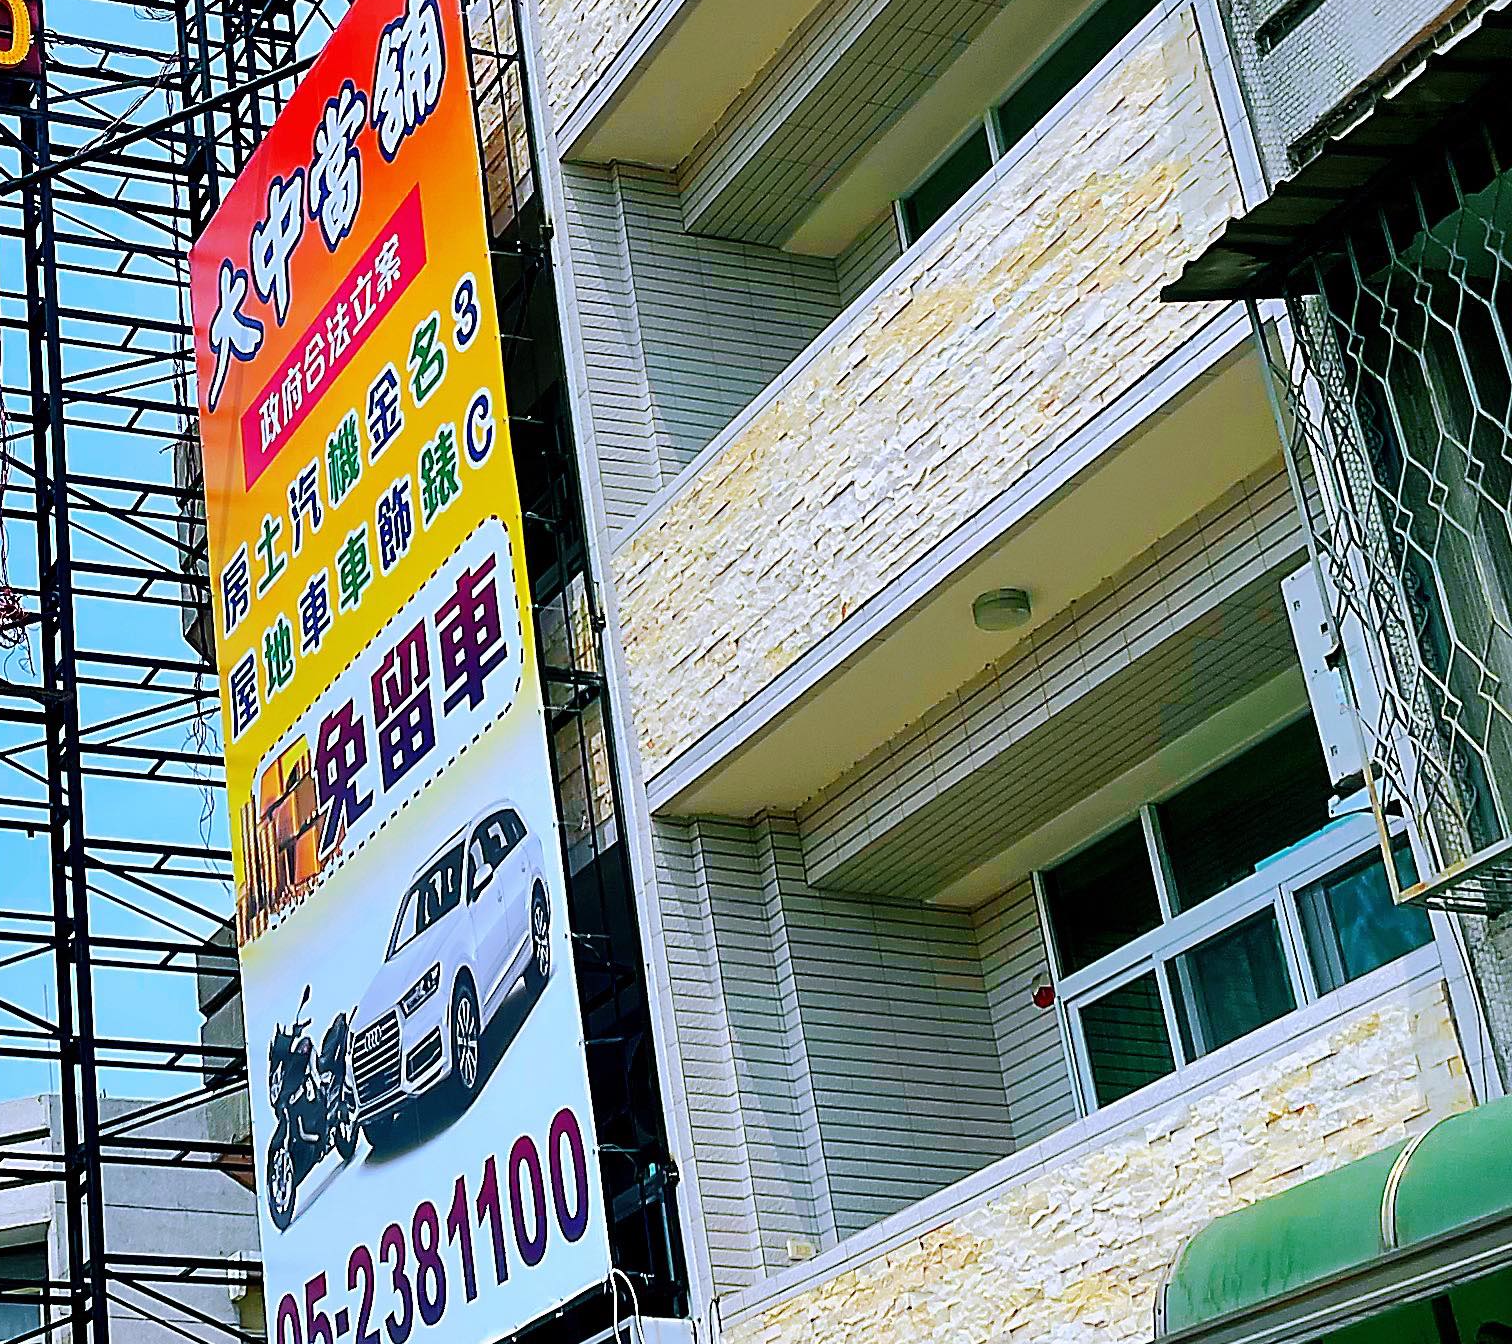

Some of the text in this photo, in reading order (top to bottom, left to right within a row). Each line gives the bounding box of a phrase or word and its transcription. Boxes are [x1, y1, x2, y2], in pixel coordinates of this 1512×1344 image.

[258, 231, 404, 456] 政府合法立案
[315, 564, 509, 855] 免留車
